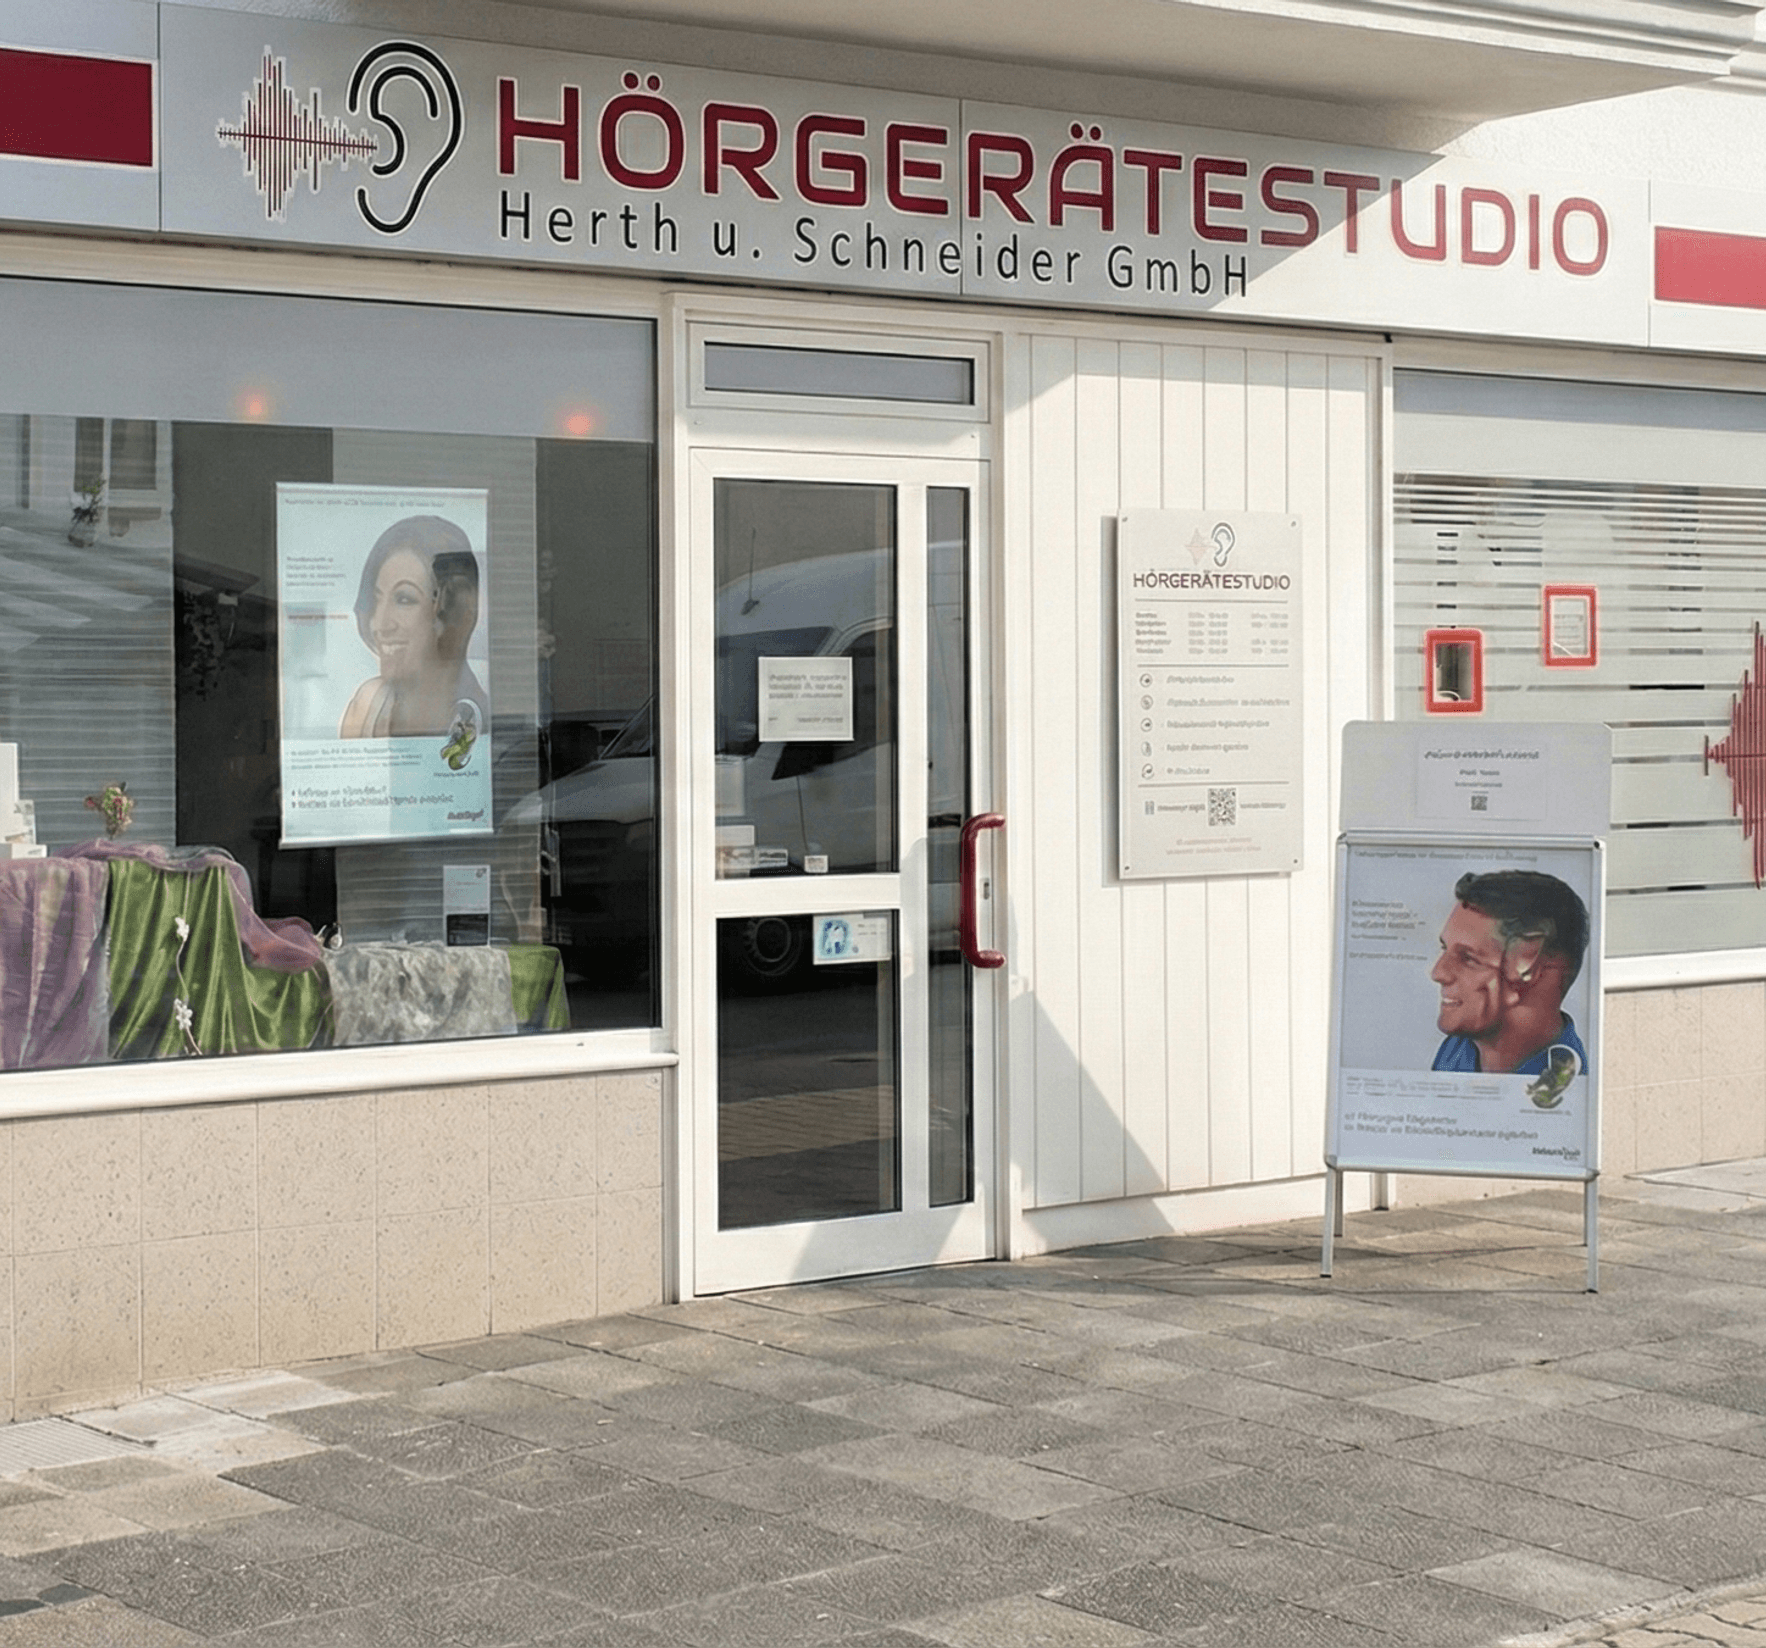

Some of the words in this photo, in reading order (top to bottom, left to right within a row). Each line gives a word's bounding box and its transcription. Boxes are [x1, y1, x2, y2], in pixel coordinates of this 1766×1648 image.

[497, 71, 1609, 276] HÖRGERÄTESTUDIO
[500, 189, 678, 252] Herth
[713, 222, 761, 258] u.
[794, 217, 1081, 285] Schneider
[1108, 245, 1247, 298] GmbH
[1132, 568, 1291, 590] HÖRGERÄTESTUDIO
